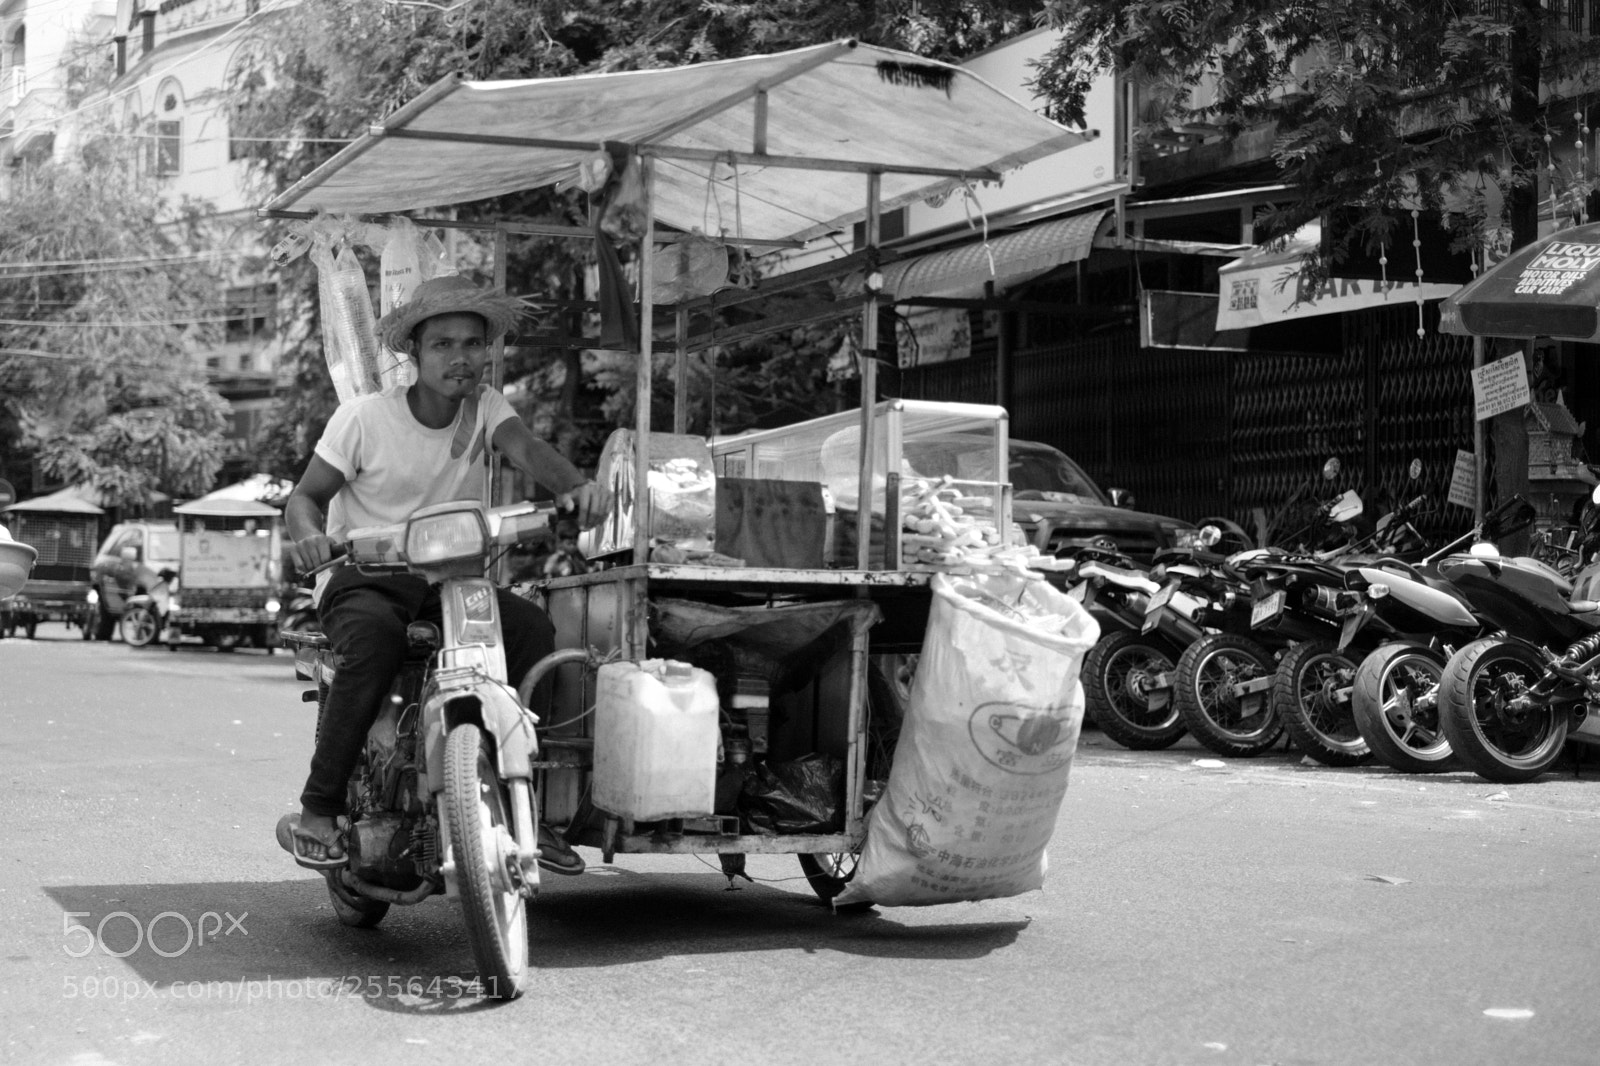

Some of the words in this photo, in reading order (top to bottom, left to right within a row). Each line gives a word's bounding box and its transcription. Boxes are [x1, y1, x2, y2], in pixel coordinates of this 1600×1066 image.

[1545, 243, 1600, 256] LIQU
[1531, 255, 1600, 269] MOLY
[1519, 269, 1561, 279] MOTOR
[1560, 271, 1587, 280] OILS
[1517, 277, 1576, 287] ADDITIVES
[1514, 285, 1538, 294] CAR
[1537, 286, 1567, 295] CARE
